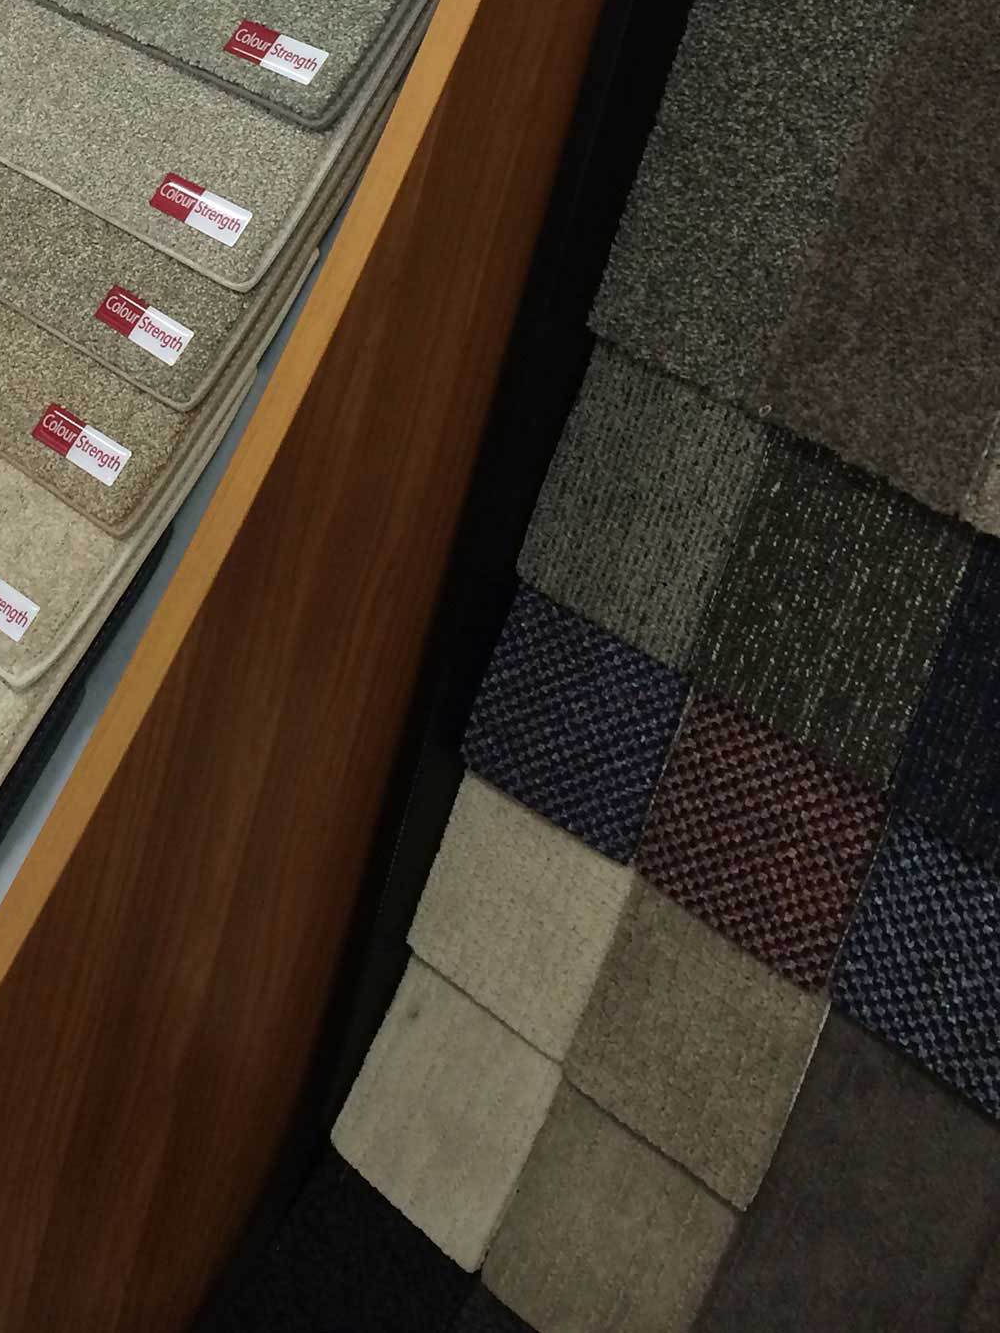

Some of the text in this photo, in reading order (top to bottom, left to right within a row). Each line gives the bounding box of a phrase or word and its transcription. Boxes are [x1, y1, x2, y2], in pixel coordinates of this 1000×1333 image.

[235, 28, 318, 72] Colour Strength
[159, 182, 242, 233] Colour Strength
[105, 296, 183, 353] Colour Strength
[42, 413, 121, 472] Colour Strength
